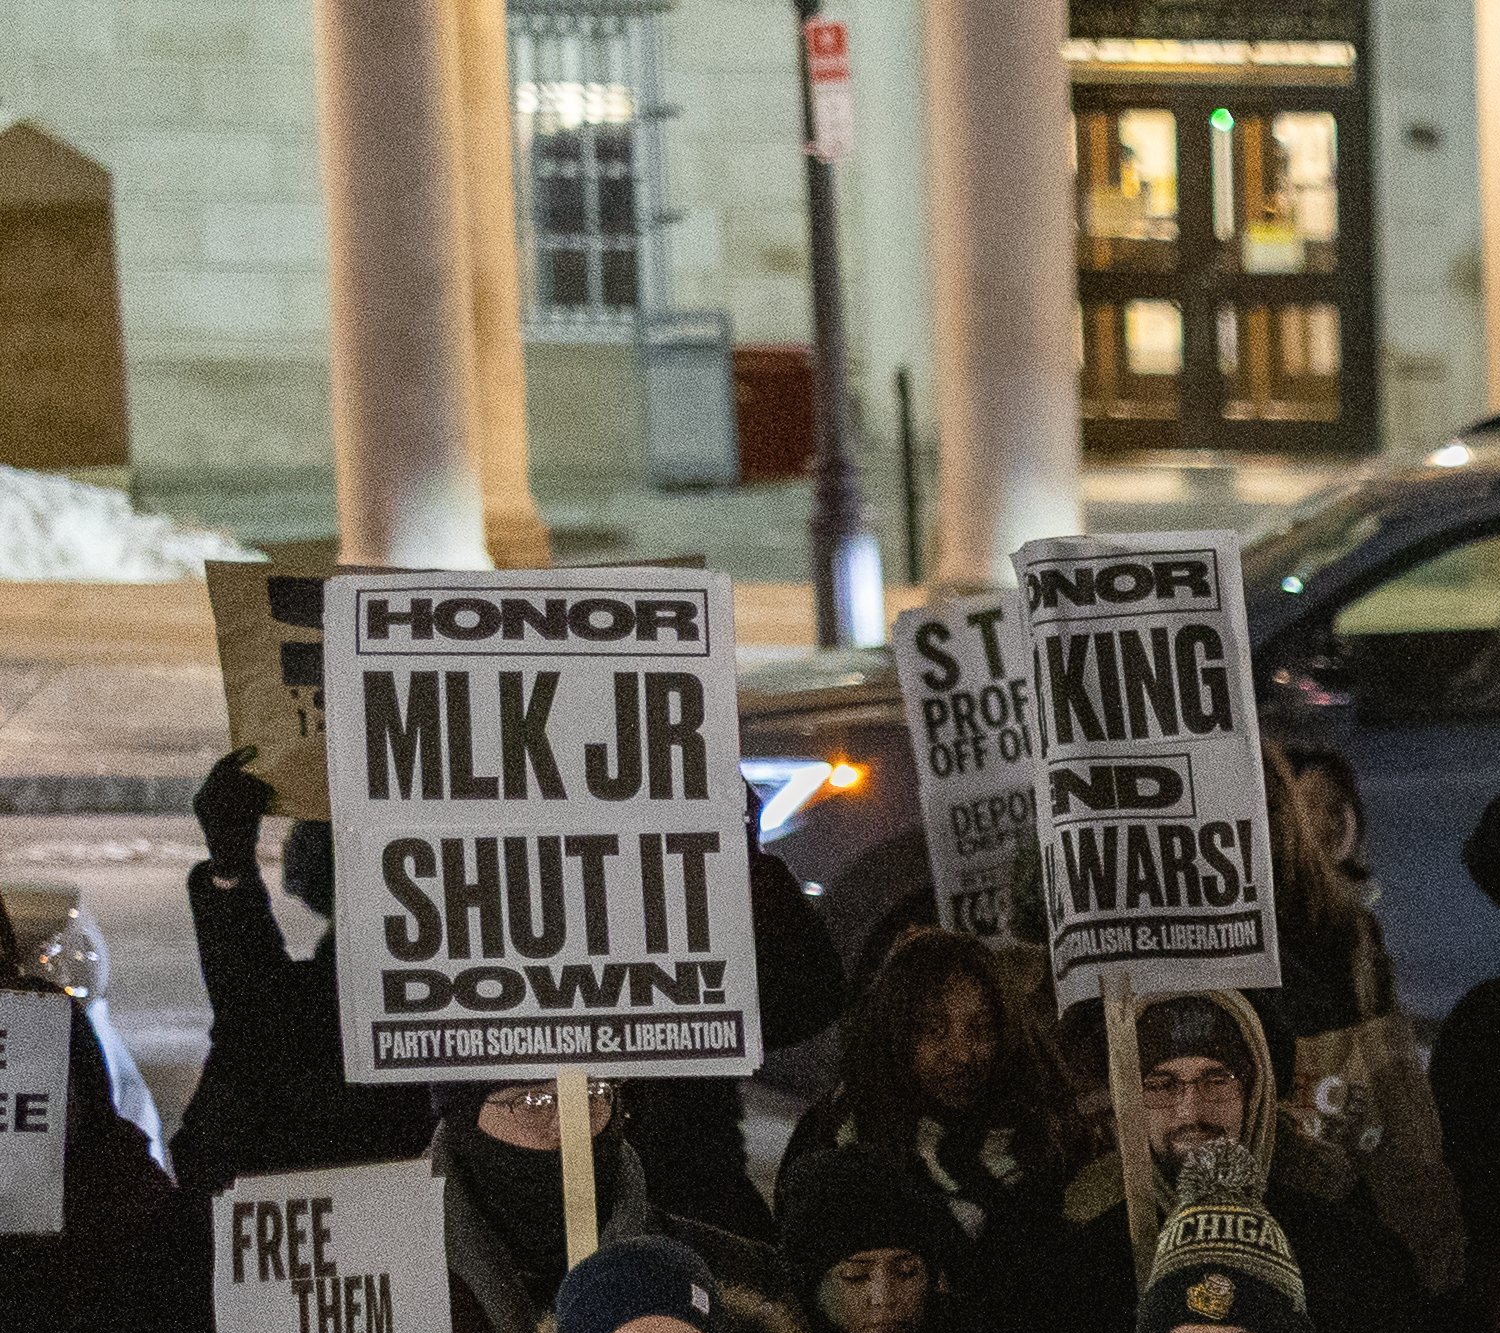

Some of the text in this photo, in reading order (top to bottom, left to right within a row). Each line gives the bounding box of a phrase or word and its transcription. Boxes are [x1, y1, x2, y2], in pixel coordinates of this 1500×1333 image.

[367, 598, 700, 642] HONOR
[1046, 624, 1234, 746] KING
[363, 671, 709, 800] MLK JR
[930, 733, 988, 778] OFF
[1049, 764, 1184, 817] ND
[1061, 818, 1258, 913] WARS!
[382, 832, 720, 962] SHUT IT
[1135, 923, 1160, 950] &
[1161, 921, 1257, 950] LIBERATION
[382, 960, 727, 1014] DOWN!
[379, 1021, 737, 1059] PARTY FOR SOCIALISM & LIBERATION
[232, 1198, 337, 1284] FREE
